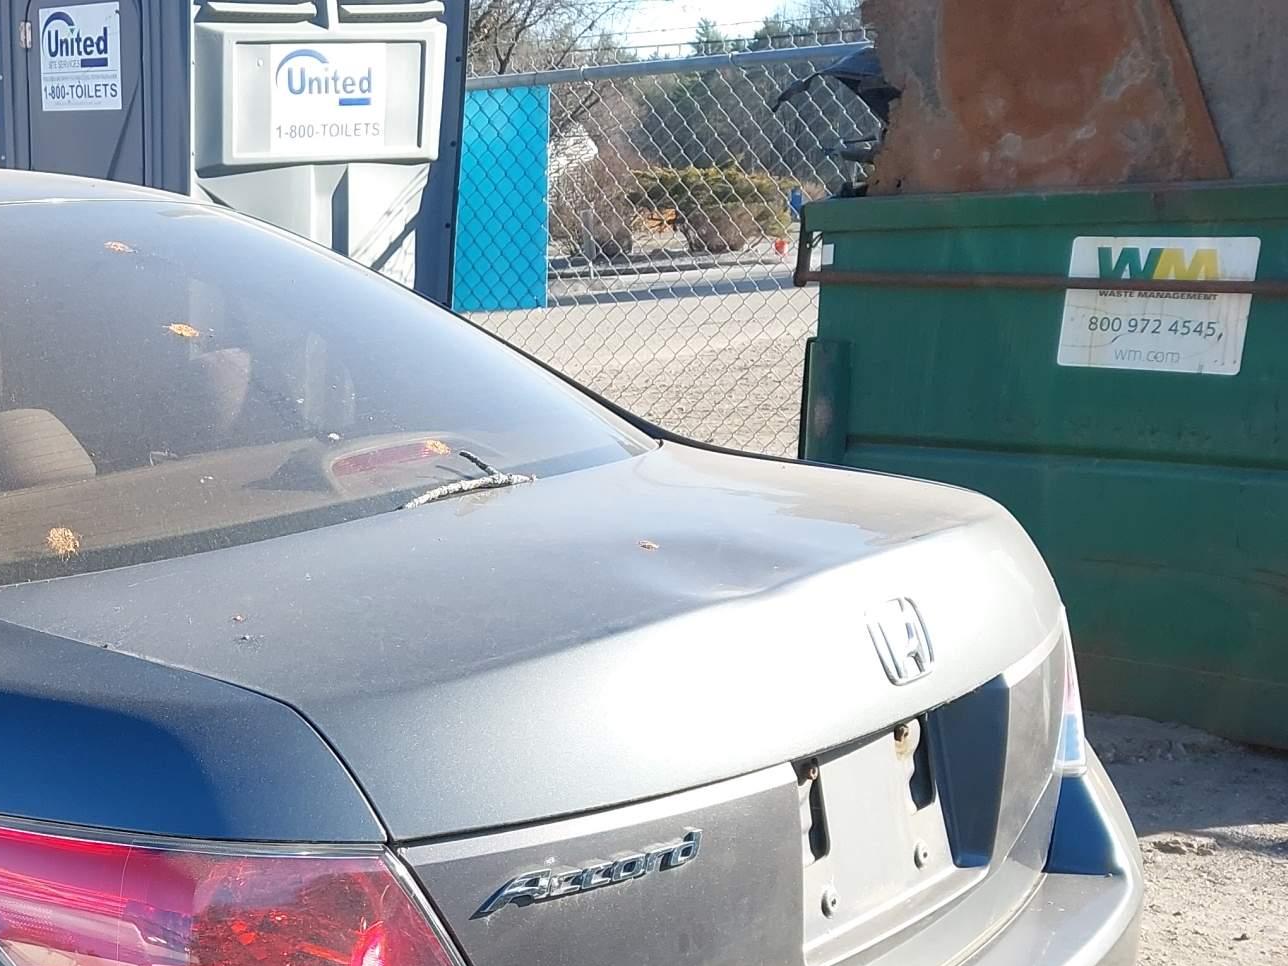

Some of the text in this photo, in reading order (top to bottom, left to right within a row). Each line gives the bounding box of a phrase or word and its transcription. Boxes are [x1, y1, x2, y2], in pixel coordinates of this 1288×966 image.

[47, 26, 109, 58] United
[287, 67, 373, 95] United
[44, 82, 119, 100] 1-800-TOILETS
[276, 122, 381, 139] 1-800-TOILETS
[1097, 246, 1220, 281] WM
[1098, 289, 1219, 301] WASTE MANAGEMENT
[1088, 316, 1122, 333] 800
[1127, 318, 1161, 334] 972
[1114, 348, 1181, 364] wm.com
[469, 826, 703, 921] Accord
